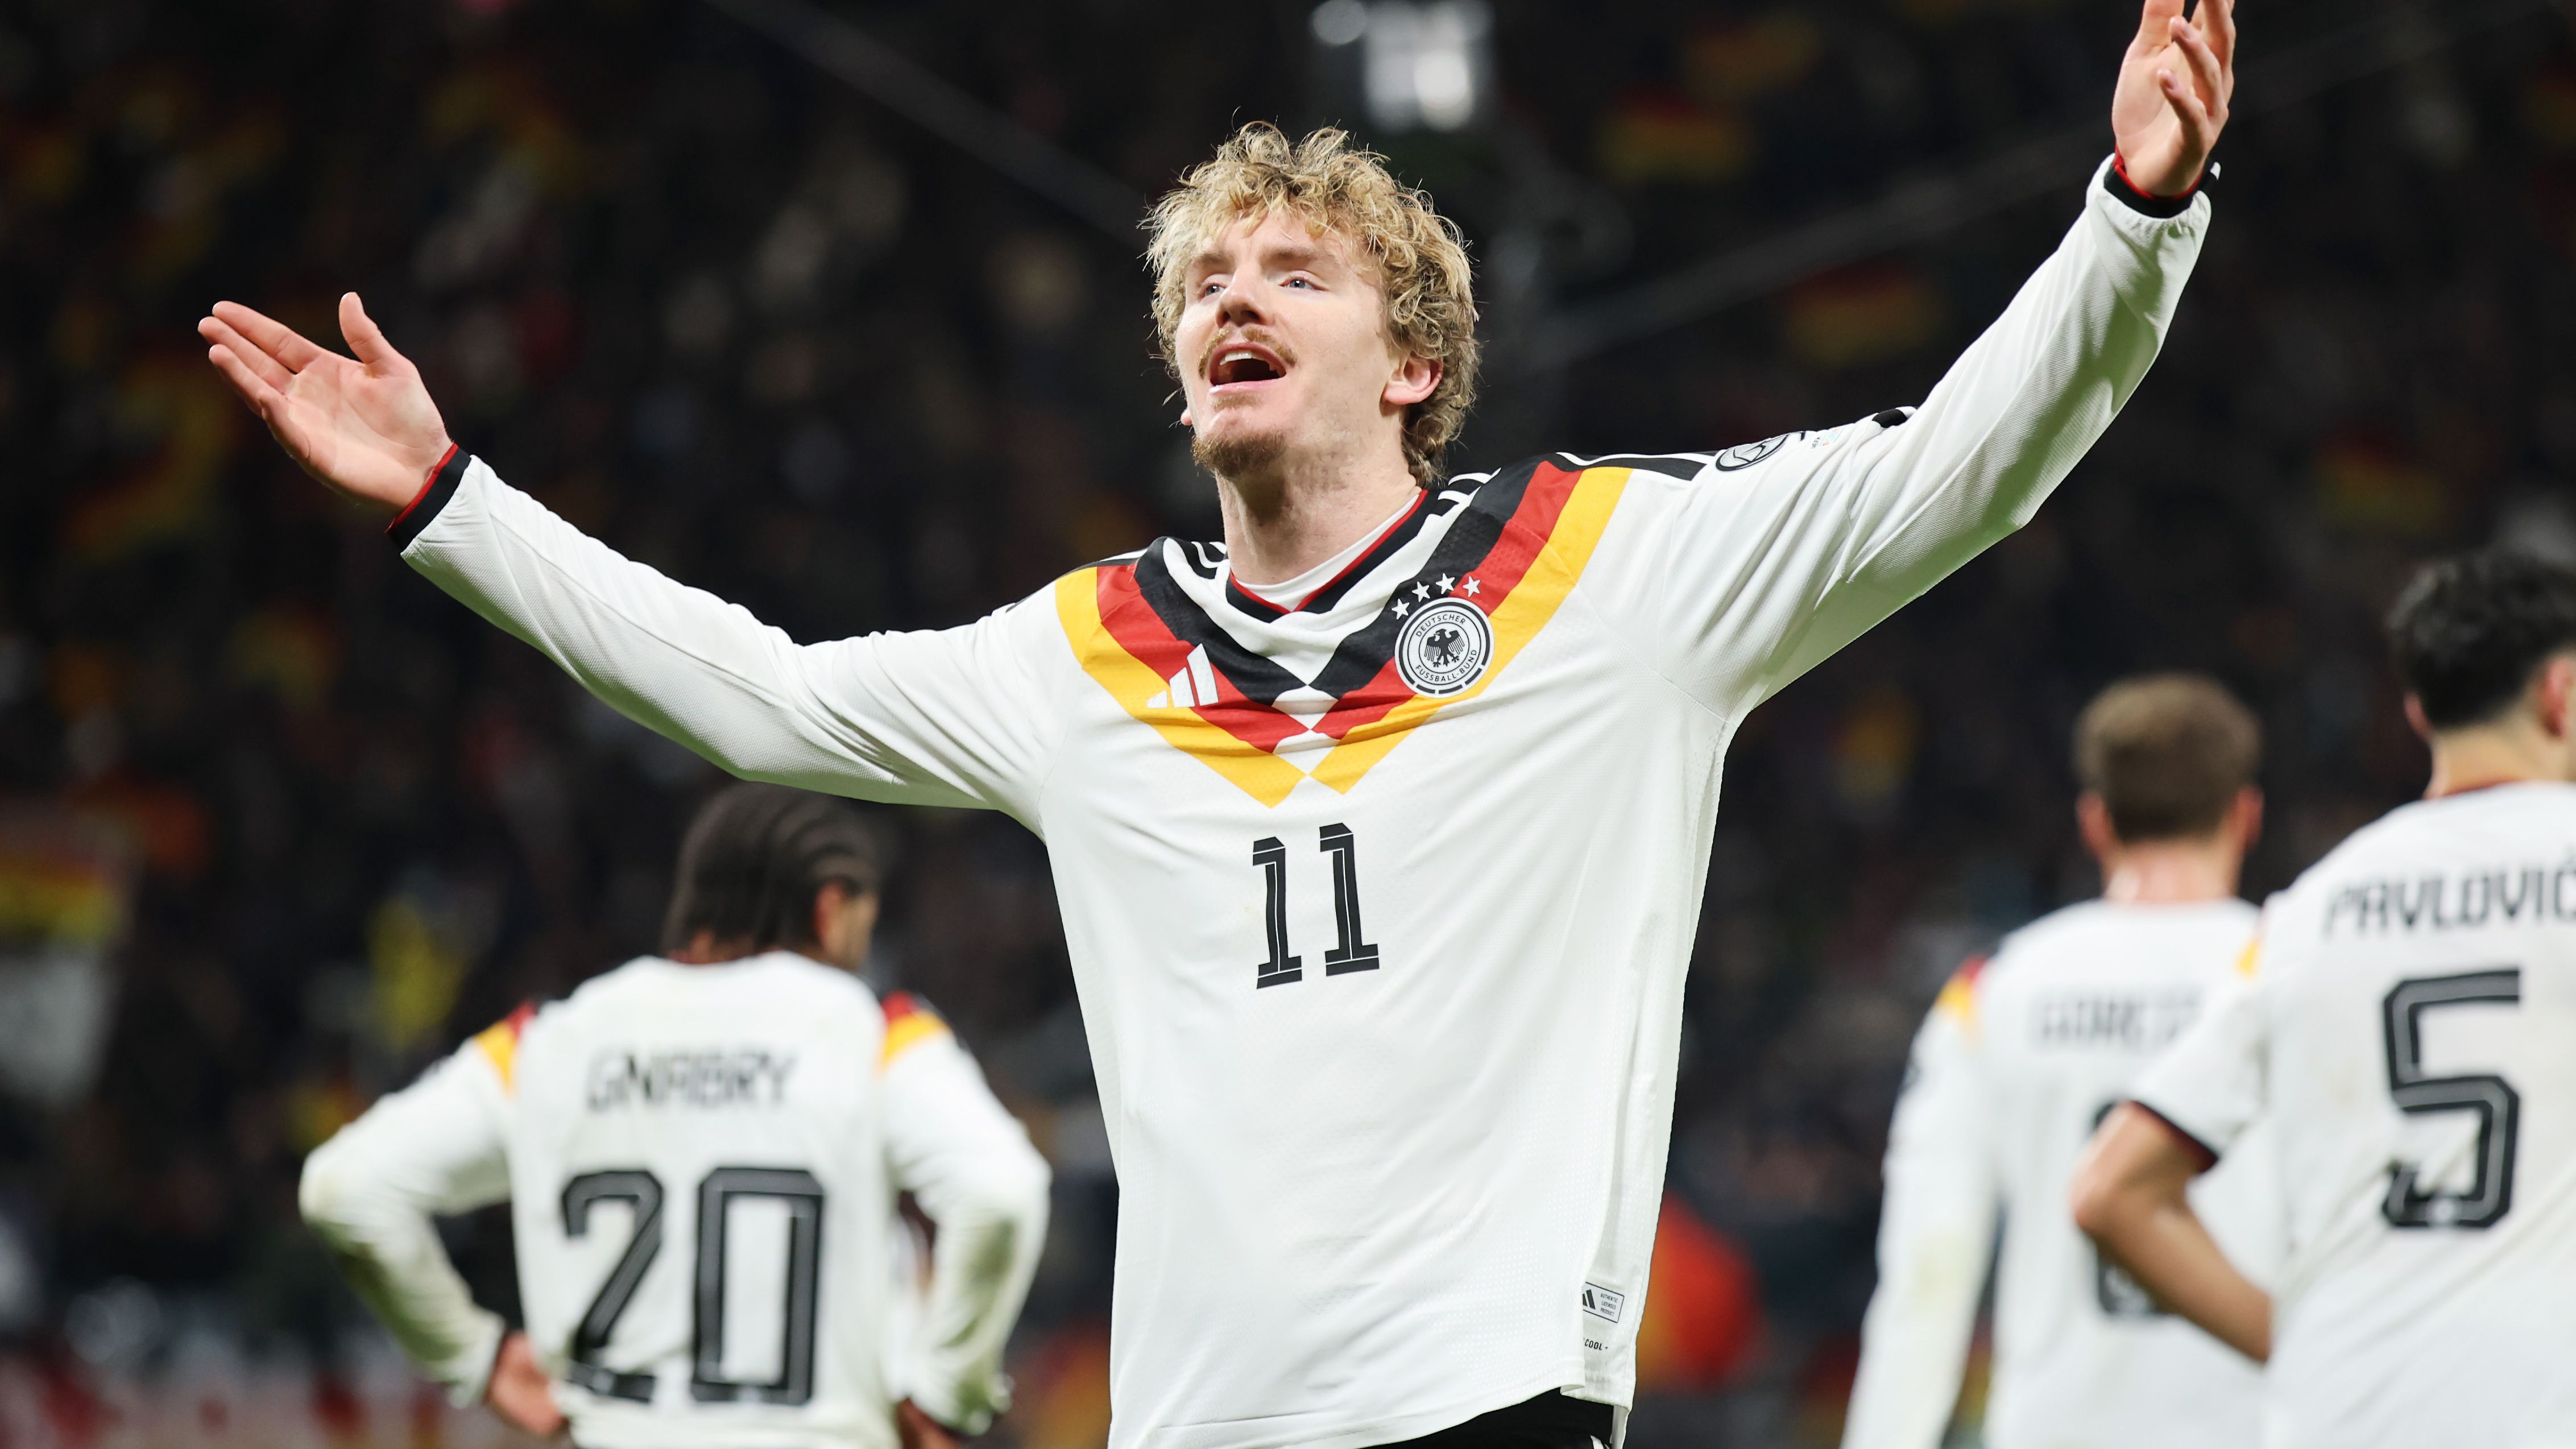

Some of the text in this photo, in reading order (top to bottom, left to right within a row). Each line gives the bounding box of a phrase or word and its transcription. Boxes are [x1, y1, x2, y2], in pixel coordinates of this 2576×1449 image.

[1416, 614, 1465, 637] DEUTSCHER
[1415, 649, 1477, 682] FUSSBALL-BUND
[1253, 822, 1380, 990] 11
[586, 1049, 797, 1112] GNABRY
[2382, 968, 2521, 1228] 5
[561, 1166, 825, 1407] 20
[1600, 1293, 1618, 1303] AUTHENTIC
[1600, 1307, 1615, 1317] PRODUCT
[1601, 1300, 1617, 1310] LICENSED
[1583, 1337, 1602, 1351] COOL
